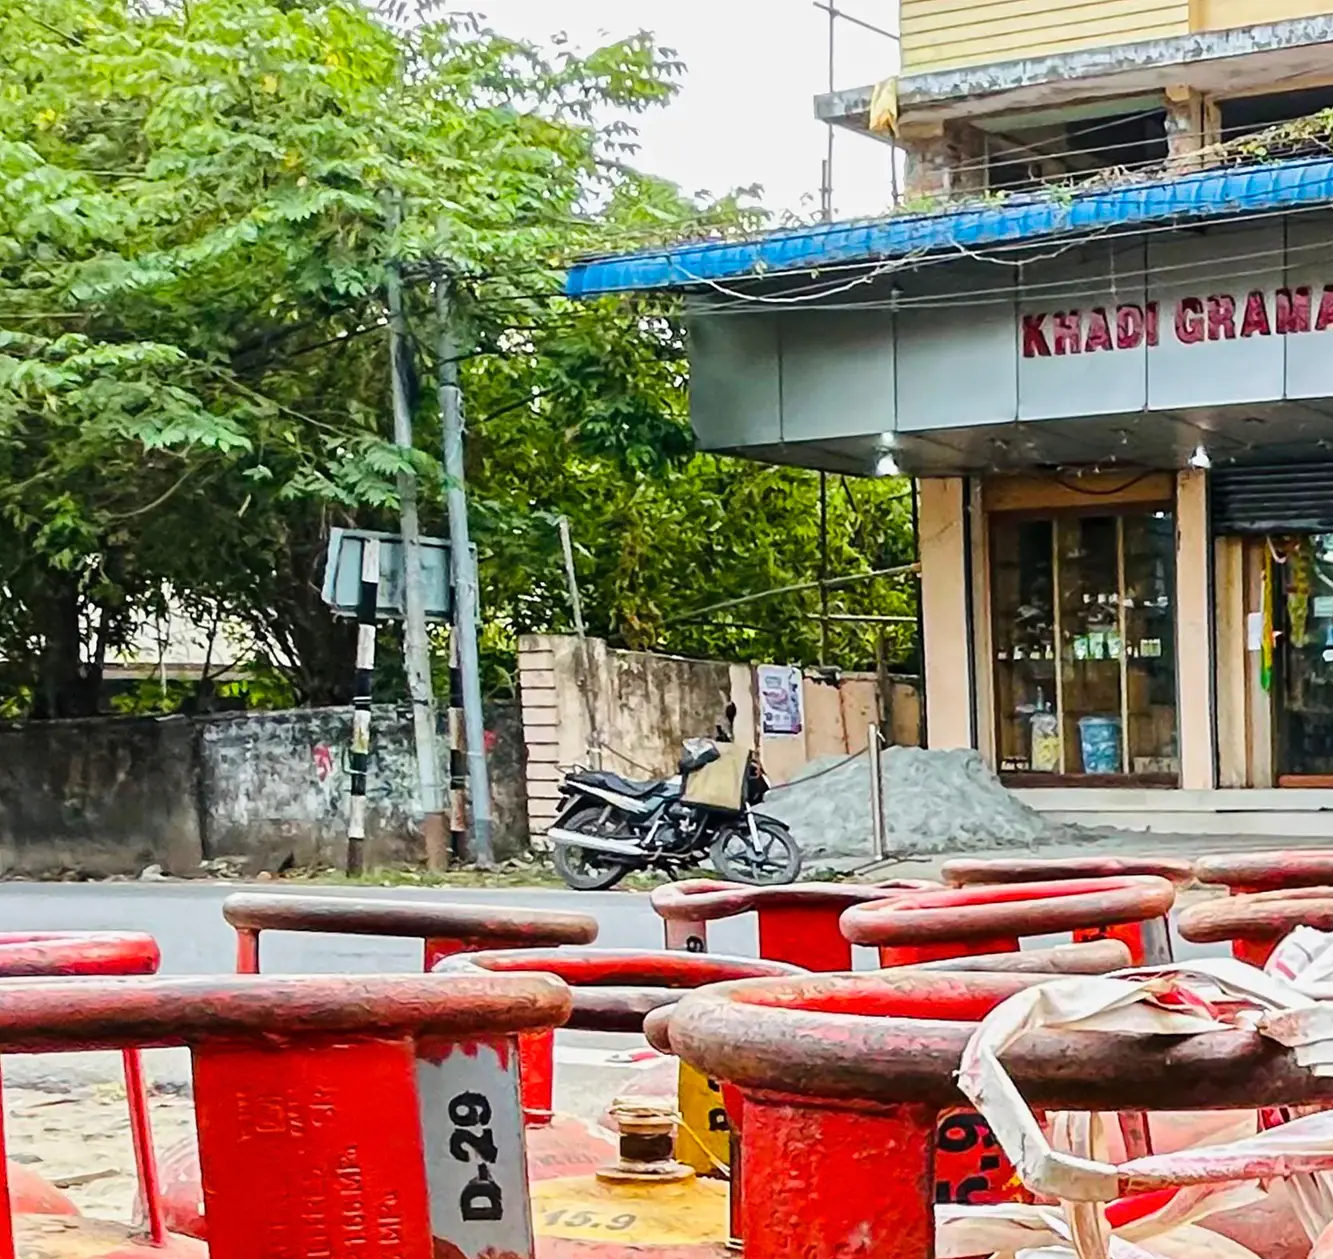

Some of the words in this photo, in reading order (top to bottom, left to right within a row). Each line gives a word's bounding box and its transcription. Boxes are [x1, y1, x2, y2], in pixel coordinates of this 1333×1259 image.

[1022, 301, 1160, 358] KHADI
[448, 1090, 503, 1222] D-29
[543, 1208, 637, 1231] 15.9
